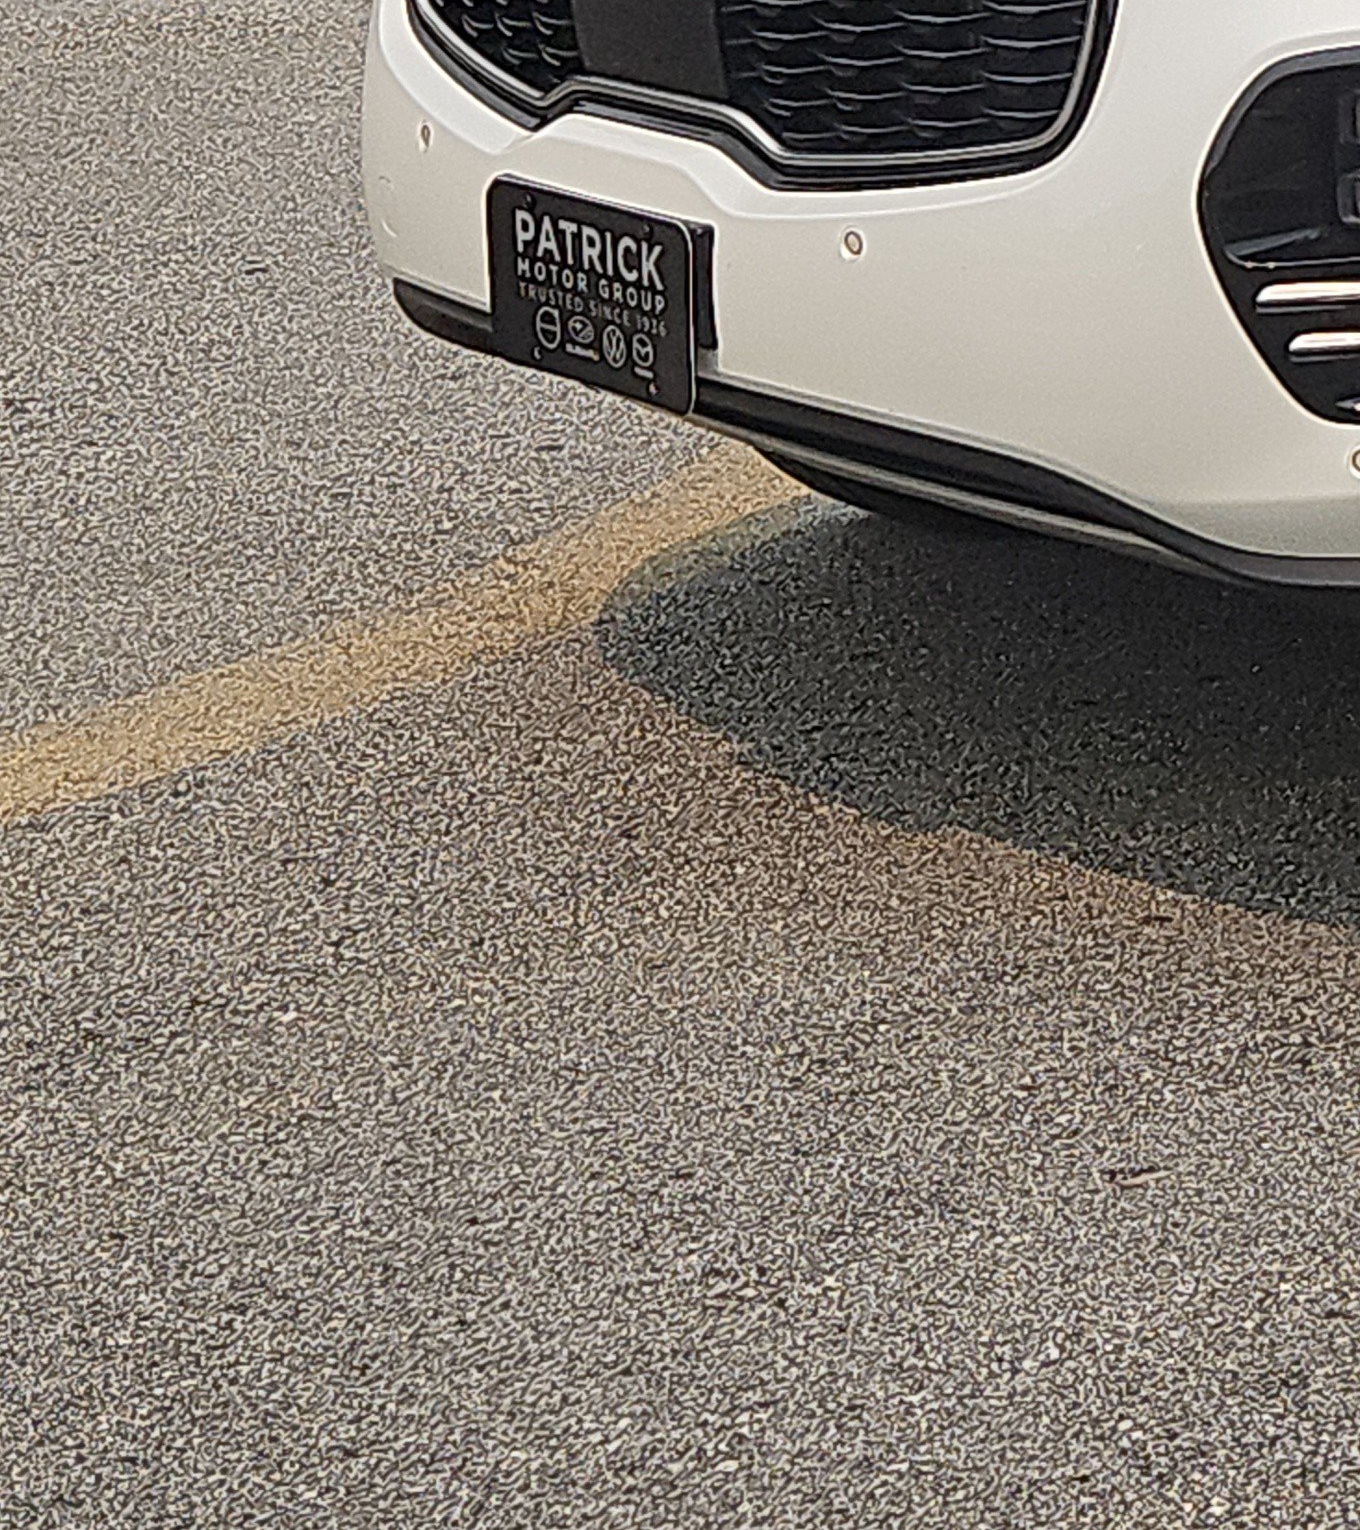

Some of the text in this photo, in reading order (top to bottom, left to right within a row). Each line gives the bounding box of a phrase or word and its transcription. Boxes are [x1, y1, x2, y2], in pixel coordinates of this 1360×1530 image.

[514, 207, 665, 291] PATRICK
[516, 256, 666, 315] MOTOR GROUP
[518, 281, 583, 312] TRUSTED
[588, 299, 631, 327] SINCE
